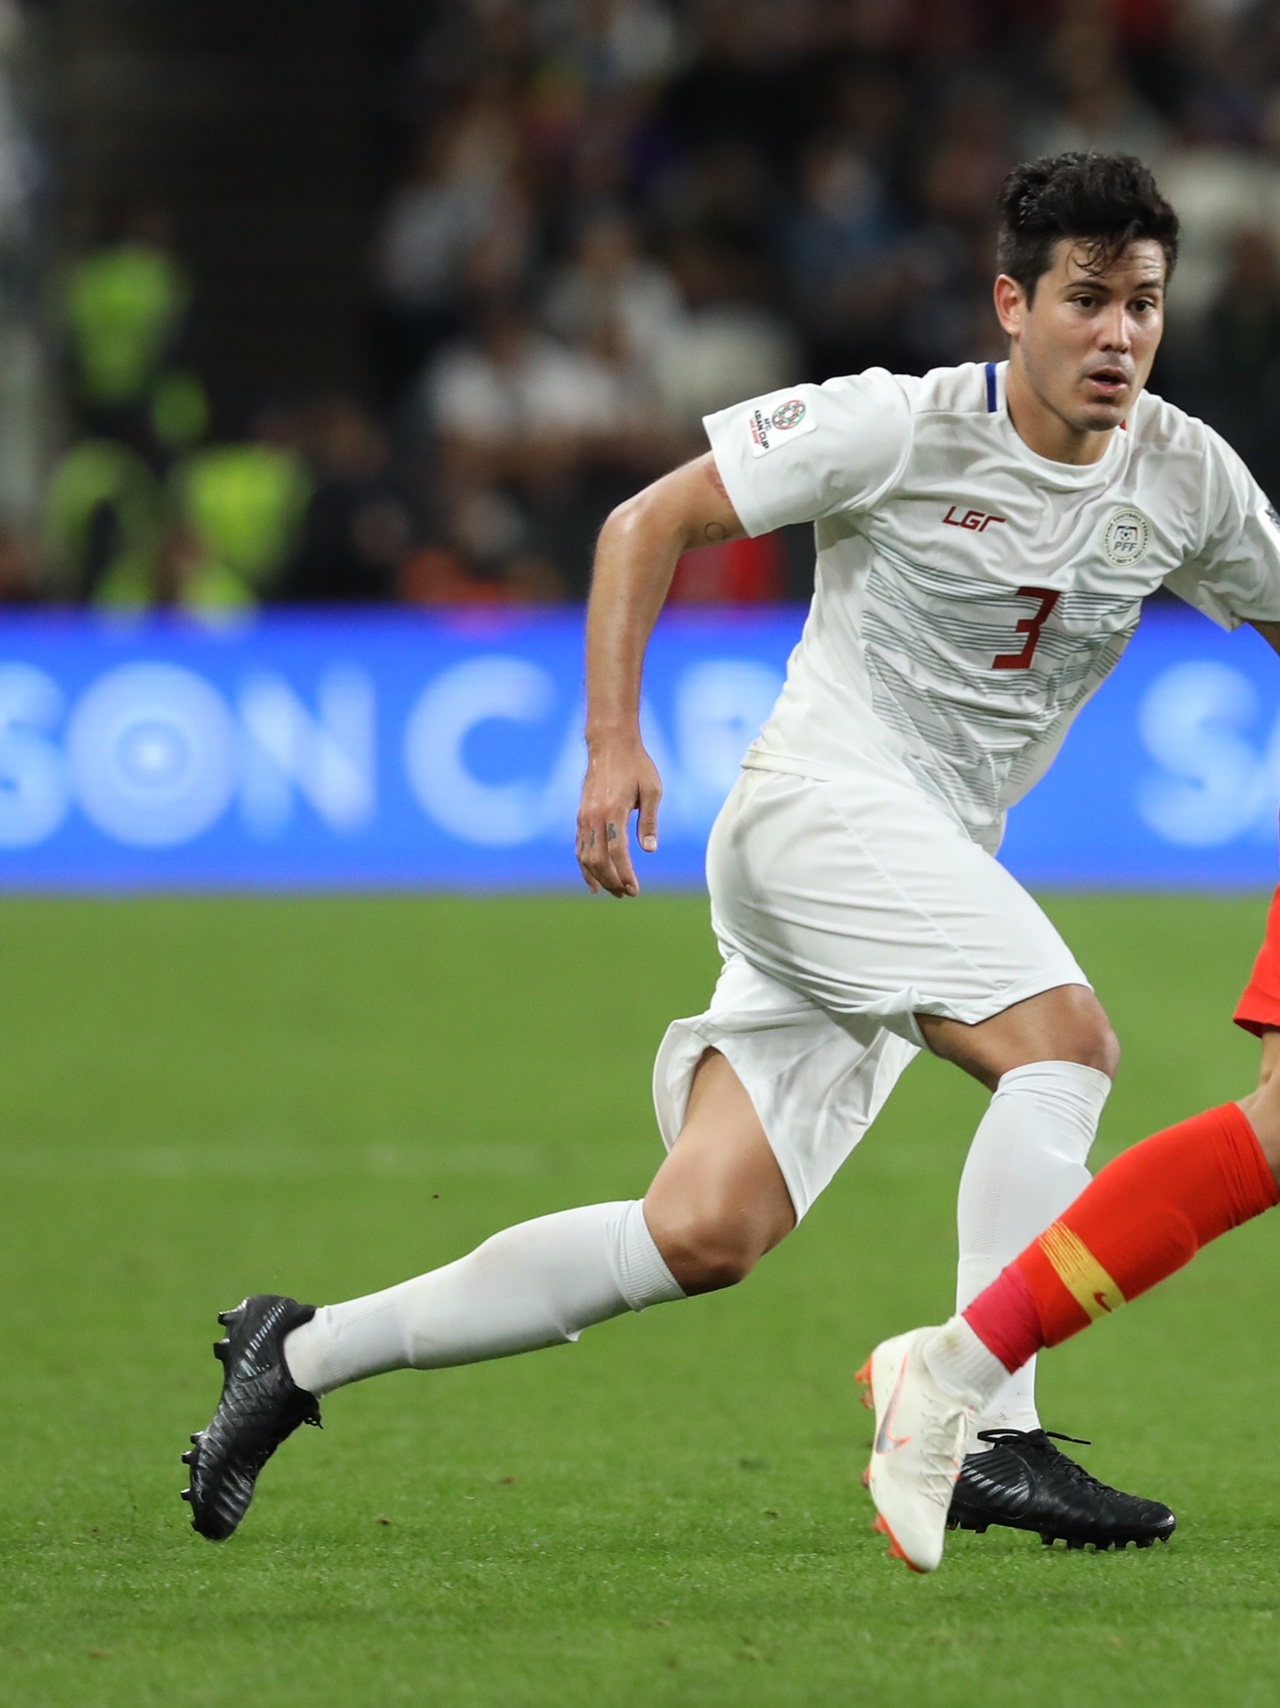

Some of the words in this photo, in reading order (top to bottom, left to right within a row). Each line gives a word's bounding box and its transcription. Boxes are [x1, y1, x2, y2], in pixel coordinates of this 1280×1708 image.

[754, 410, 764, 431] ASIAN
[758, 431, 770, 449] CUP
[1113, 541, 1138, 552] PFF
[992, 586, 1061, 669] 3
